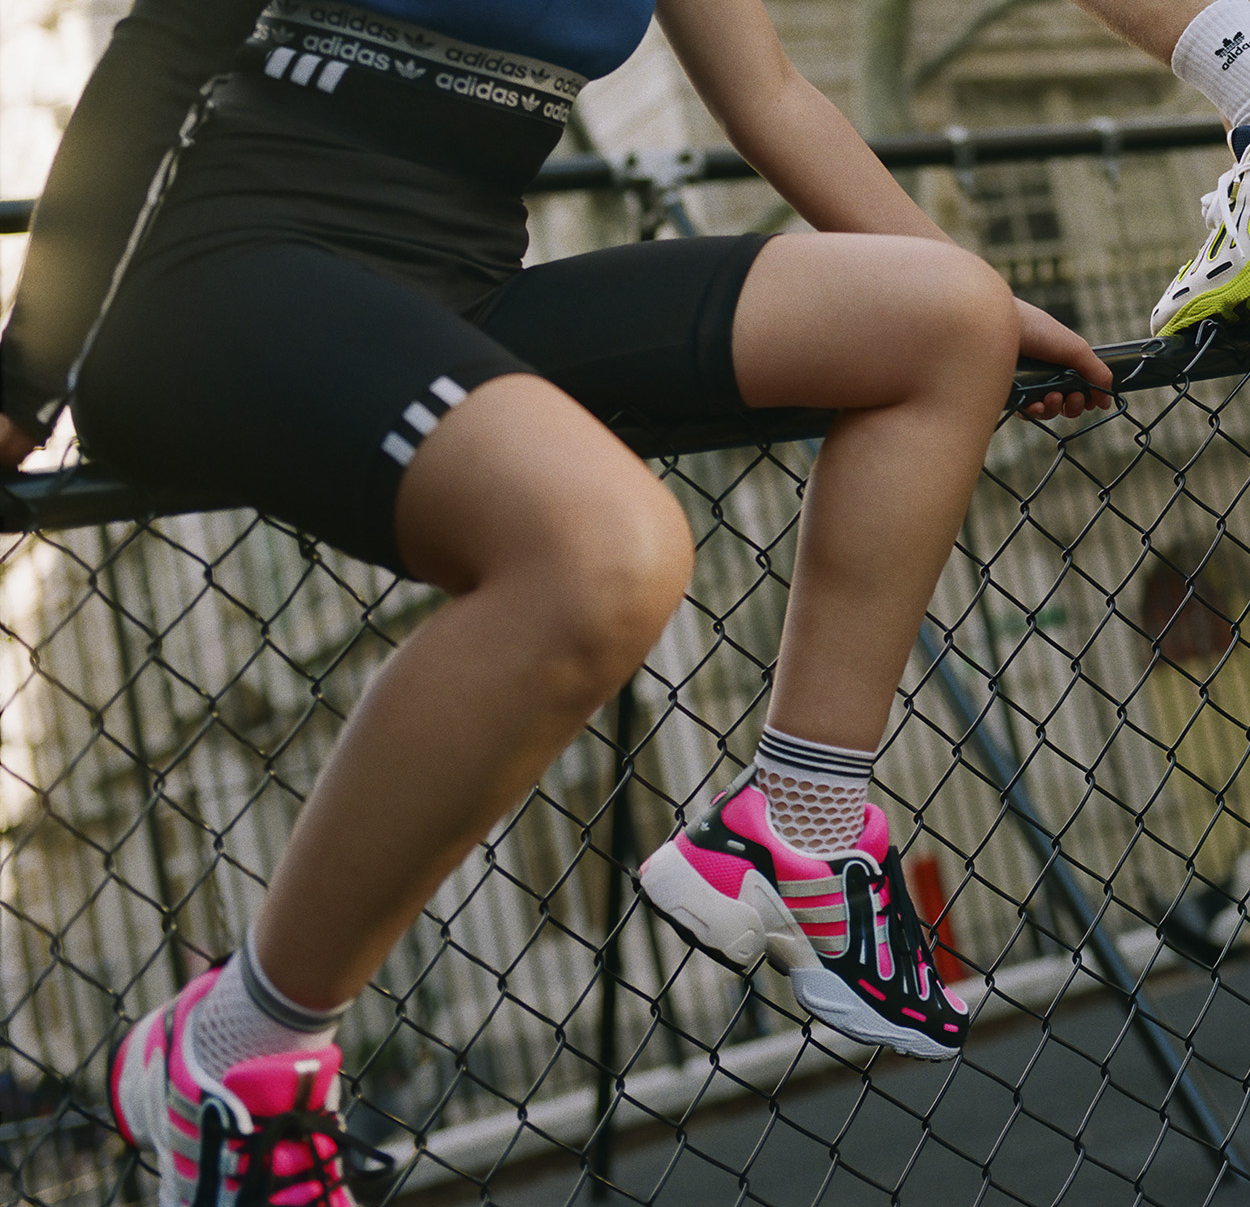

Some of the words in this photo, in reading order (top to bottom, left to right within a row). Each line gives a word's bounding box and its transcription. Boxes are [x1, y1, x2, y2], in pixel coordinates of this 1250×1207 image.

[303, 35, 392, 71] adidas
[435, 72, 519, 107] adidas
[310, 8, 399, 42] adidas
[445, 48, 528, 79] adidas
